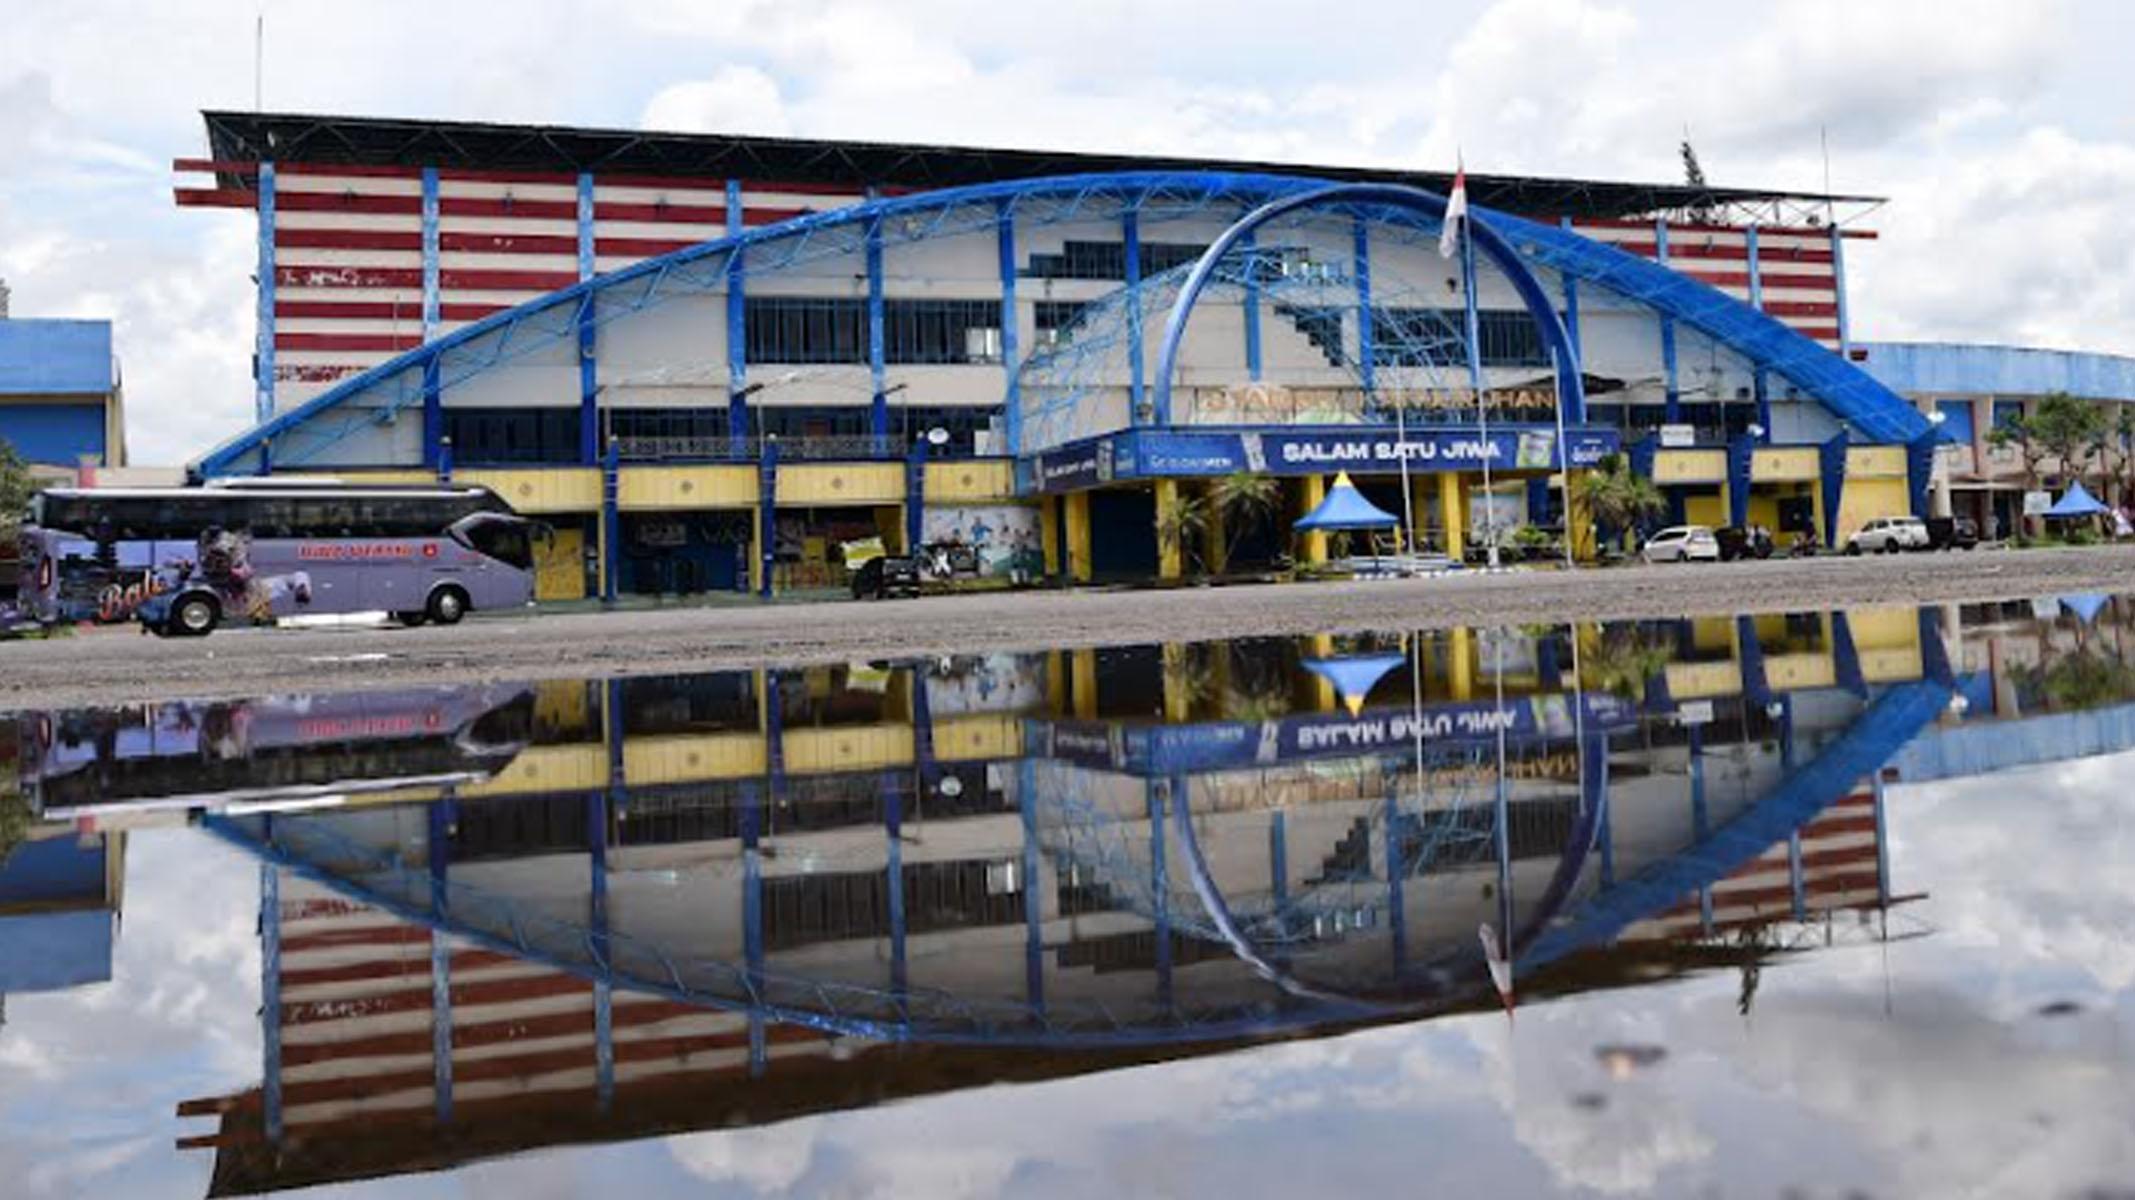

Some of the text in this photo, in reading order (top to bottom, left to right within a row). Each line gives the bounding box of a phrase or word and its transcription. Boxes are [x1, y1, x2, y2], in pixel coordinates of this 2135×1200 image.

[1282, 441, 1501, 462] SALAM SATU JIWA
